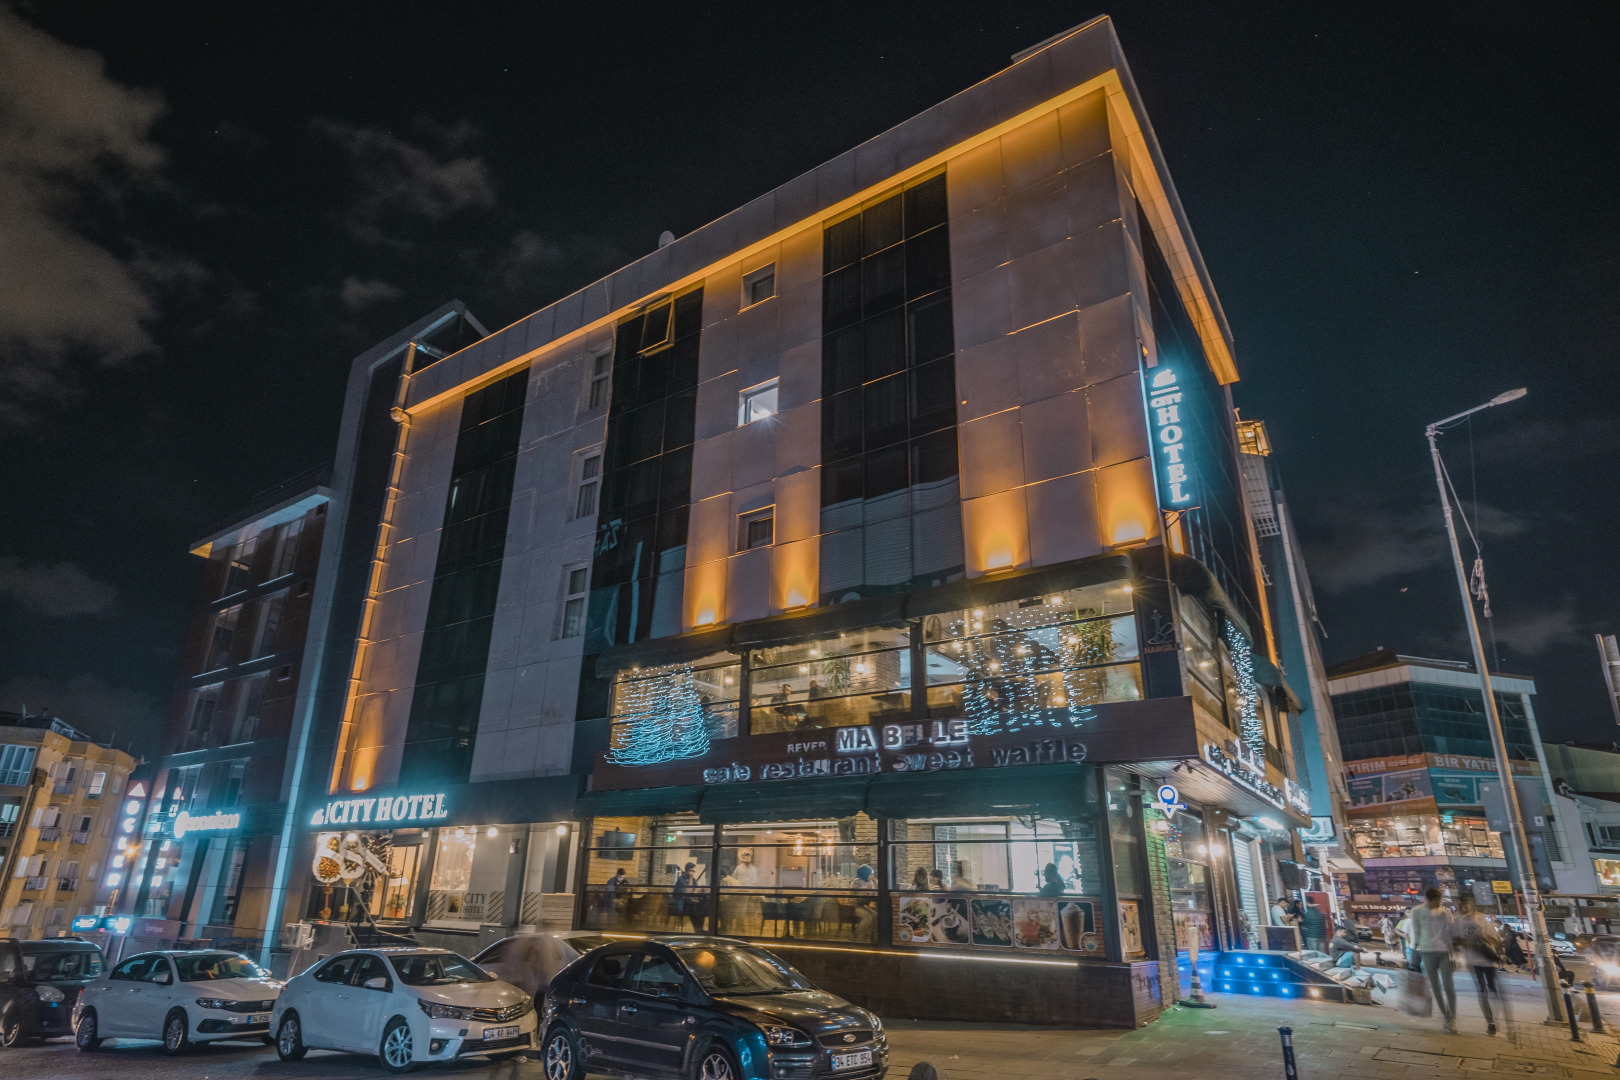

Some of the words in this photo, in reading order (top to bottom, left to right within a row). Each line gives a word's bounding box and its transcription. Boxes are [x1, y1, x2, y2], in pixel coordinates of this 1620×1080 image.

[1156, 404, 1190, 503] HOTEL
[836, 726, 877, 753] MA
[882, 718, 970, 749] BELLE
[759, 752, 882, 780] restaurant
[892, 749, 975, 772] sweet
[992, 739, 1088, 767] waffle
[329, 799, 377, 824] CITY
[375, 793, 448, 821] HOTEL
[463, 905, 485, 914] HOTEL
[464, 893, 488, 904] CITY
[836, 1056, 845, 1068] 34
[846, 1054, 858, 1066] ETC
[859, 1053, 871, 1064] 954
